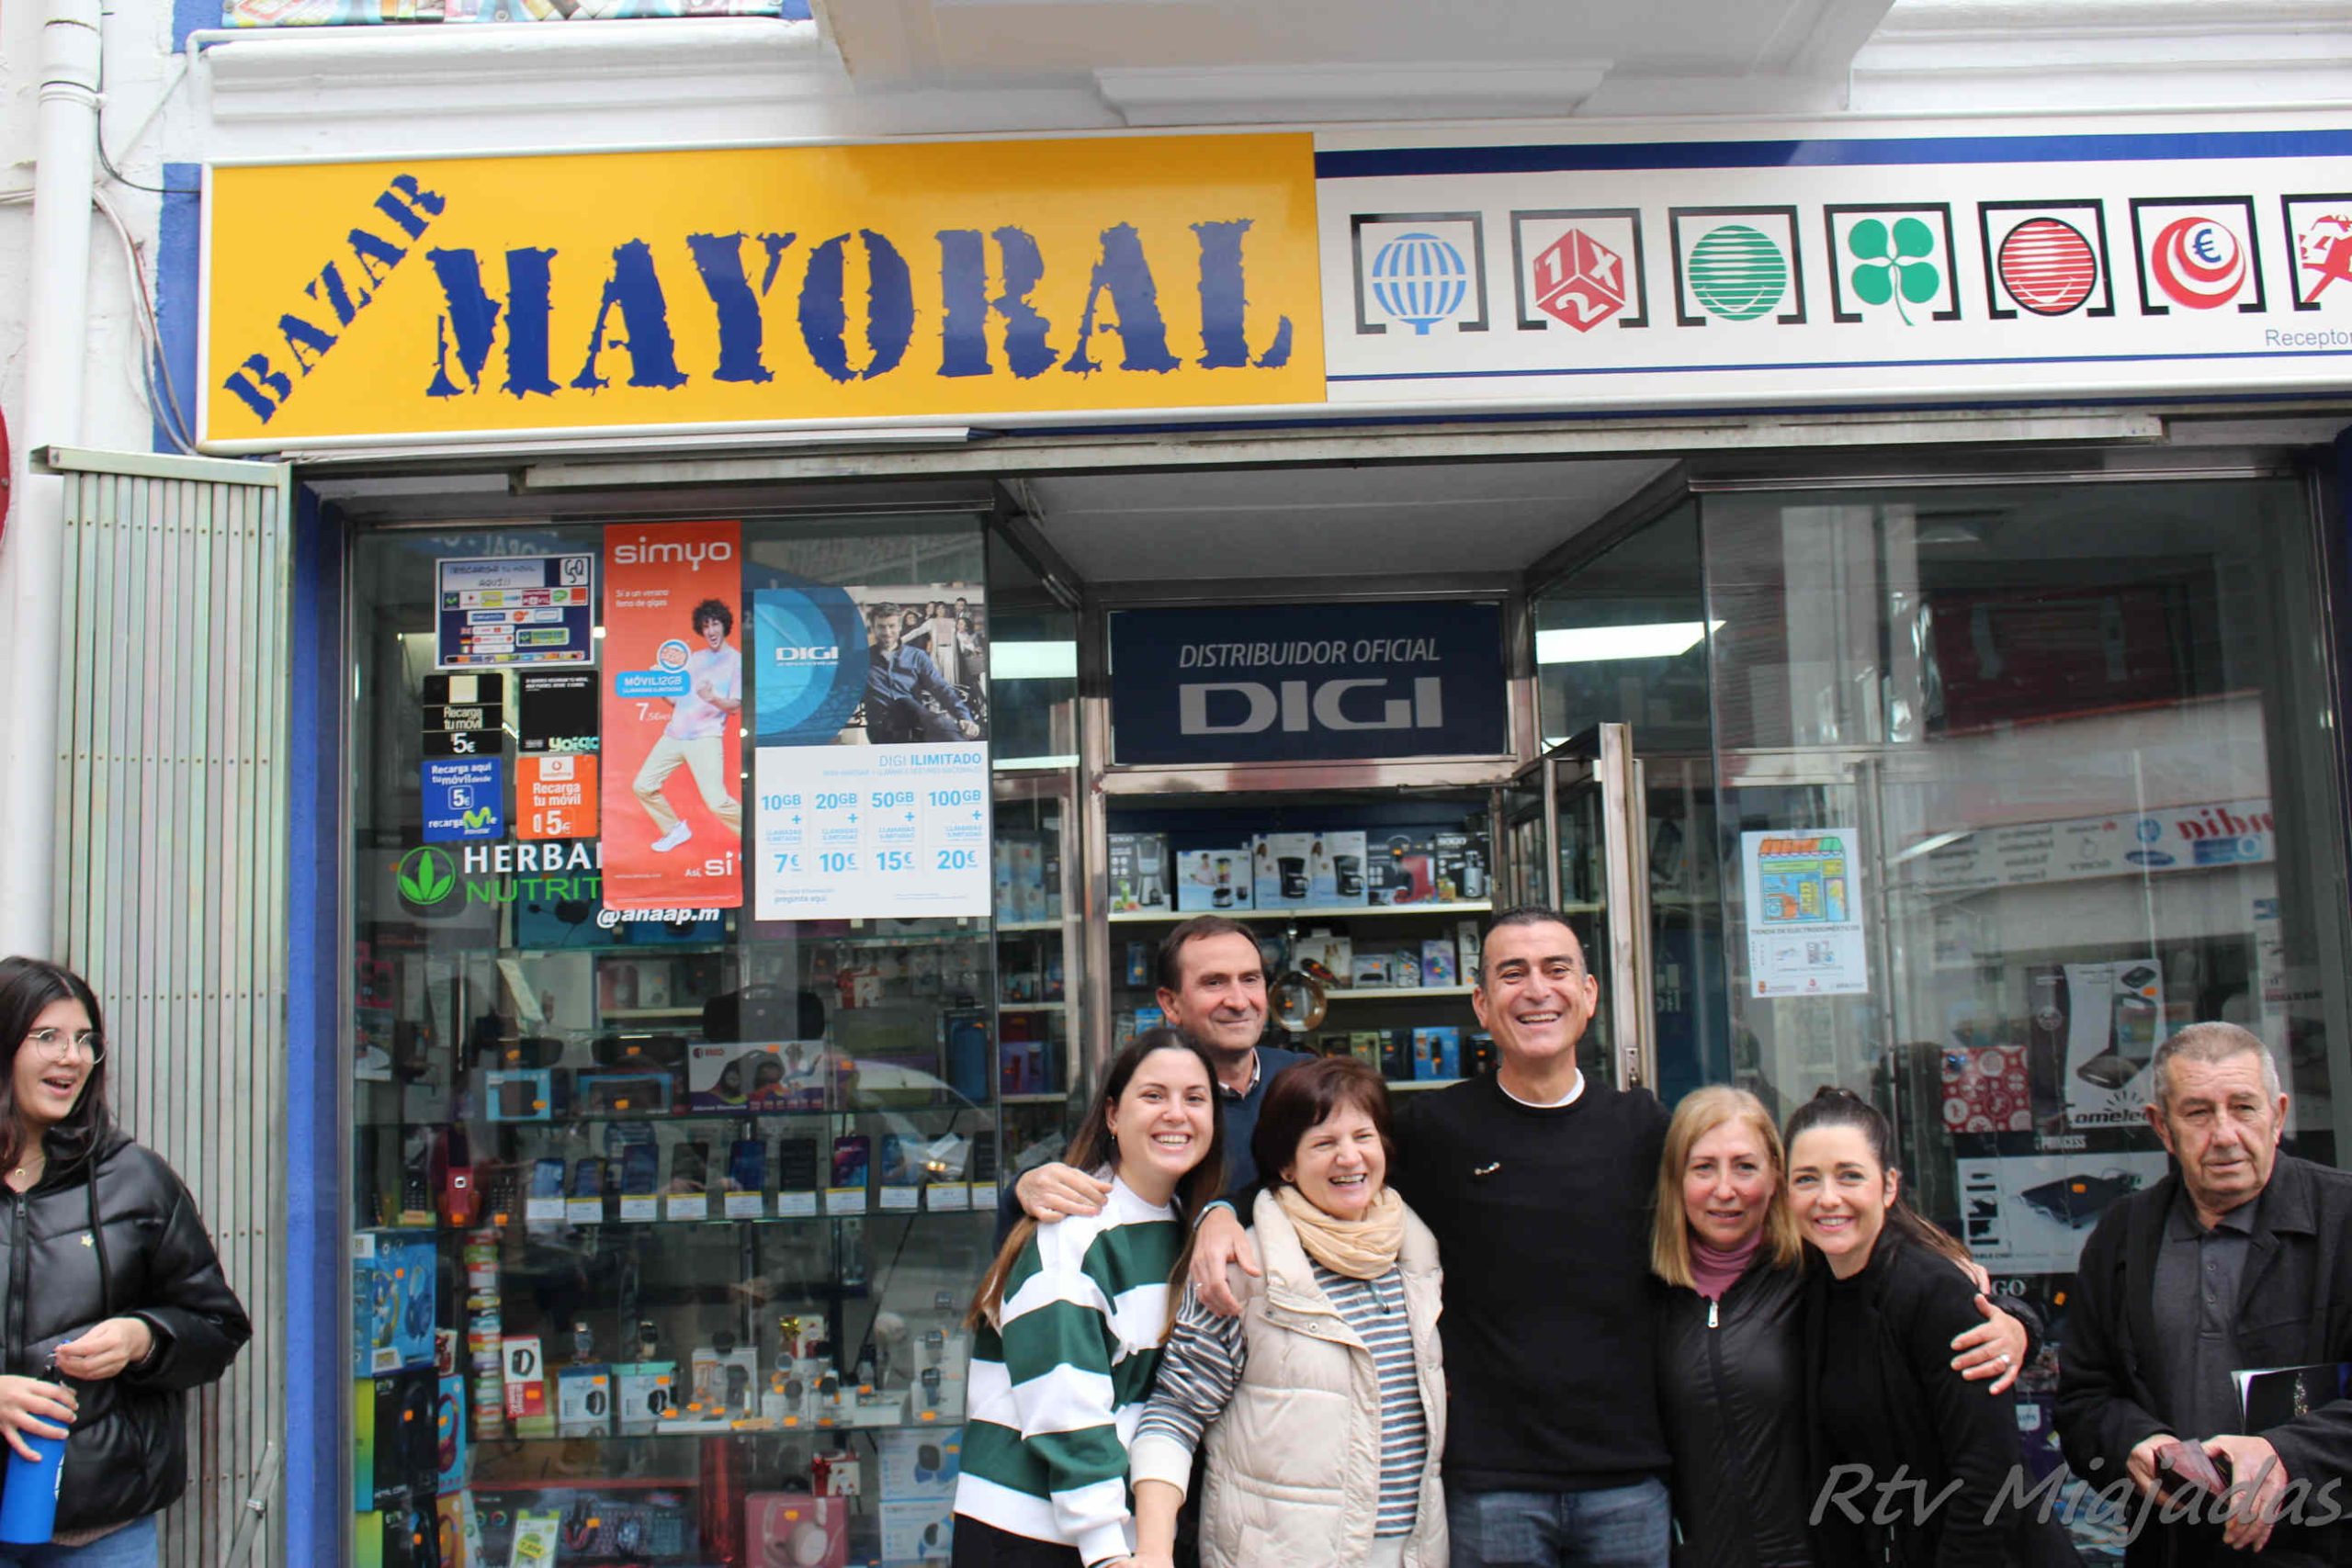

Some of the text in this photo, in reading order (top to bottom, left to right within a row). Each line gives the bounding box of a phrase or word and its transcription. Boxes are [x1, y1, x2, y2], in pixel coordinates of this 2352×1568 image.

[223, 174, 445, 424] BAZAR
[425, 220, 1292, 399] MAYORAL
[615, 536, 732, 571] simyo
[775, 646, 839, 660] DIGI
[1179, 638, 1442, 669] DISTRIBUIDOR OFICIAL
[444, 706, 482, 720] Recarga
[1179, 677, 1443, 735] DIGI
[444, 718, 455, 729] tu
[879, 753, 981, 766] DIGI ILIMITADO
[431, 764, 469, 775] Recarga
[533, 783, 581, 795] Recarga
[534, 793, 581, 807] tu móvil
[762, 794, 802, 810] 10GB
[815, 793, 858, 809] 20GB
[871, 792, 914, 808] 50GB
[929, 790, 981, 807] 100GB
[775, 852, 799, 873] 7€
[819, 852, 856, 872] 10€
[876, 851, 912, 871] 15€
[937, 850, 975, 870] 20€
